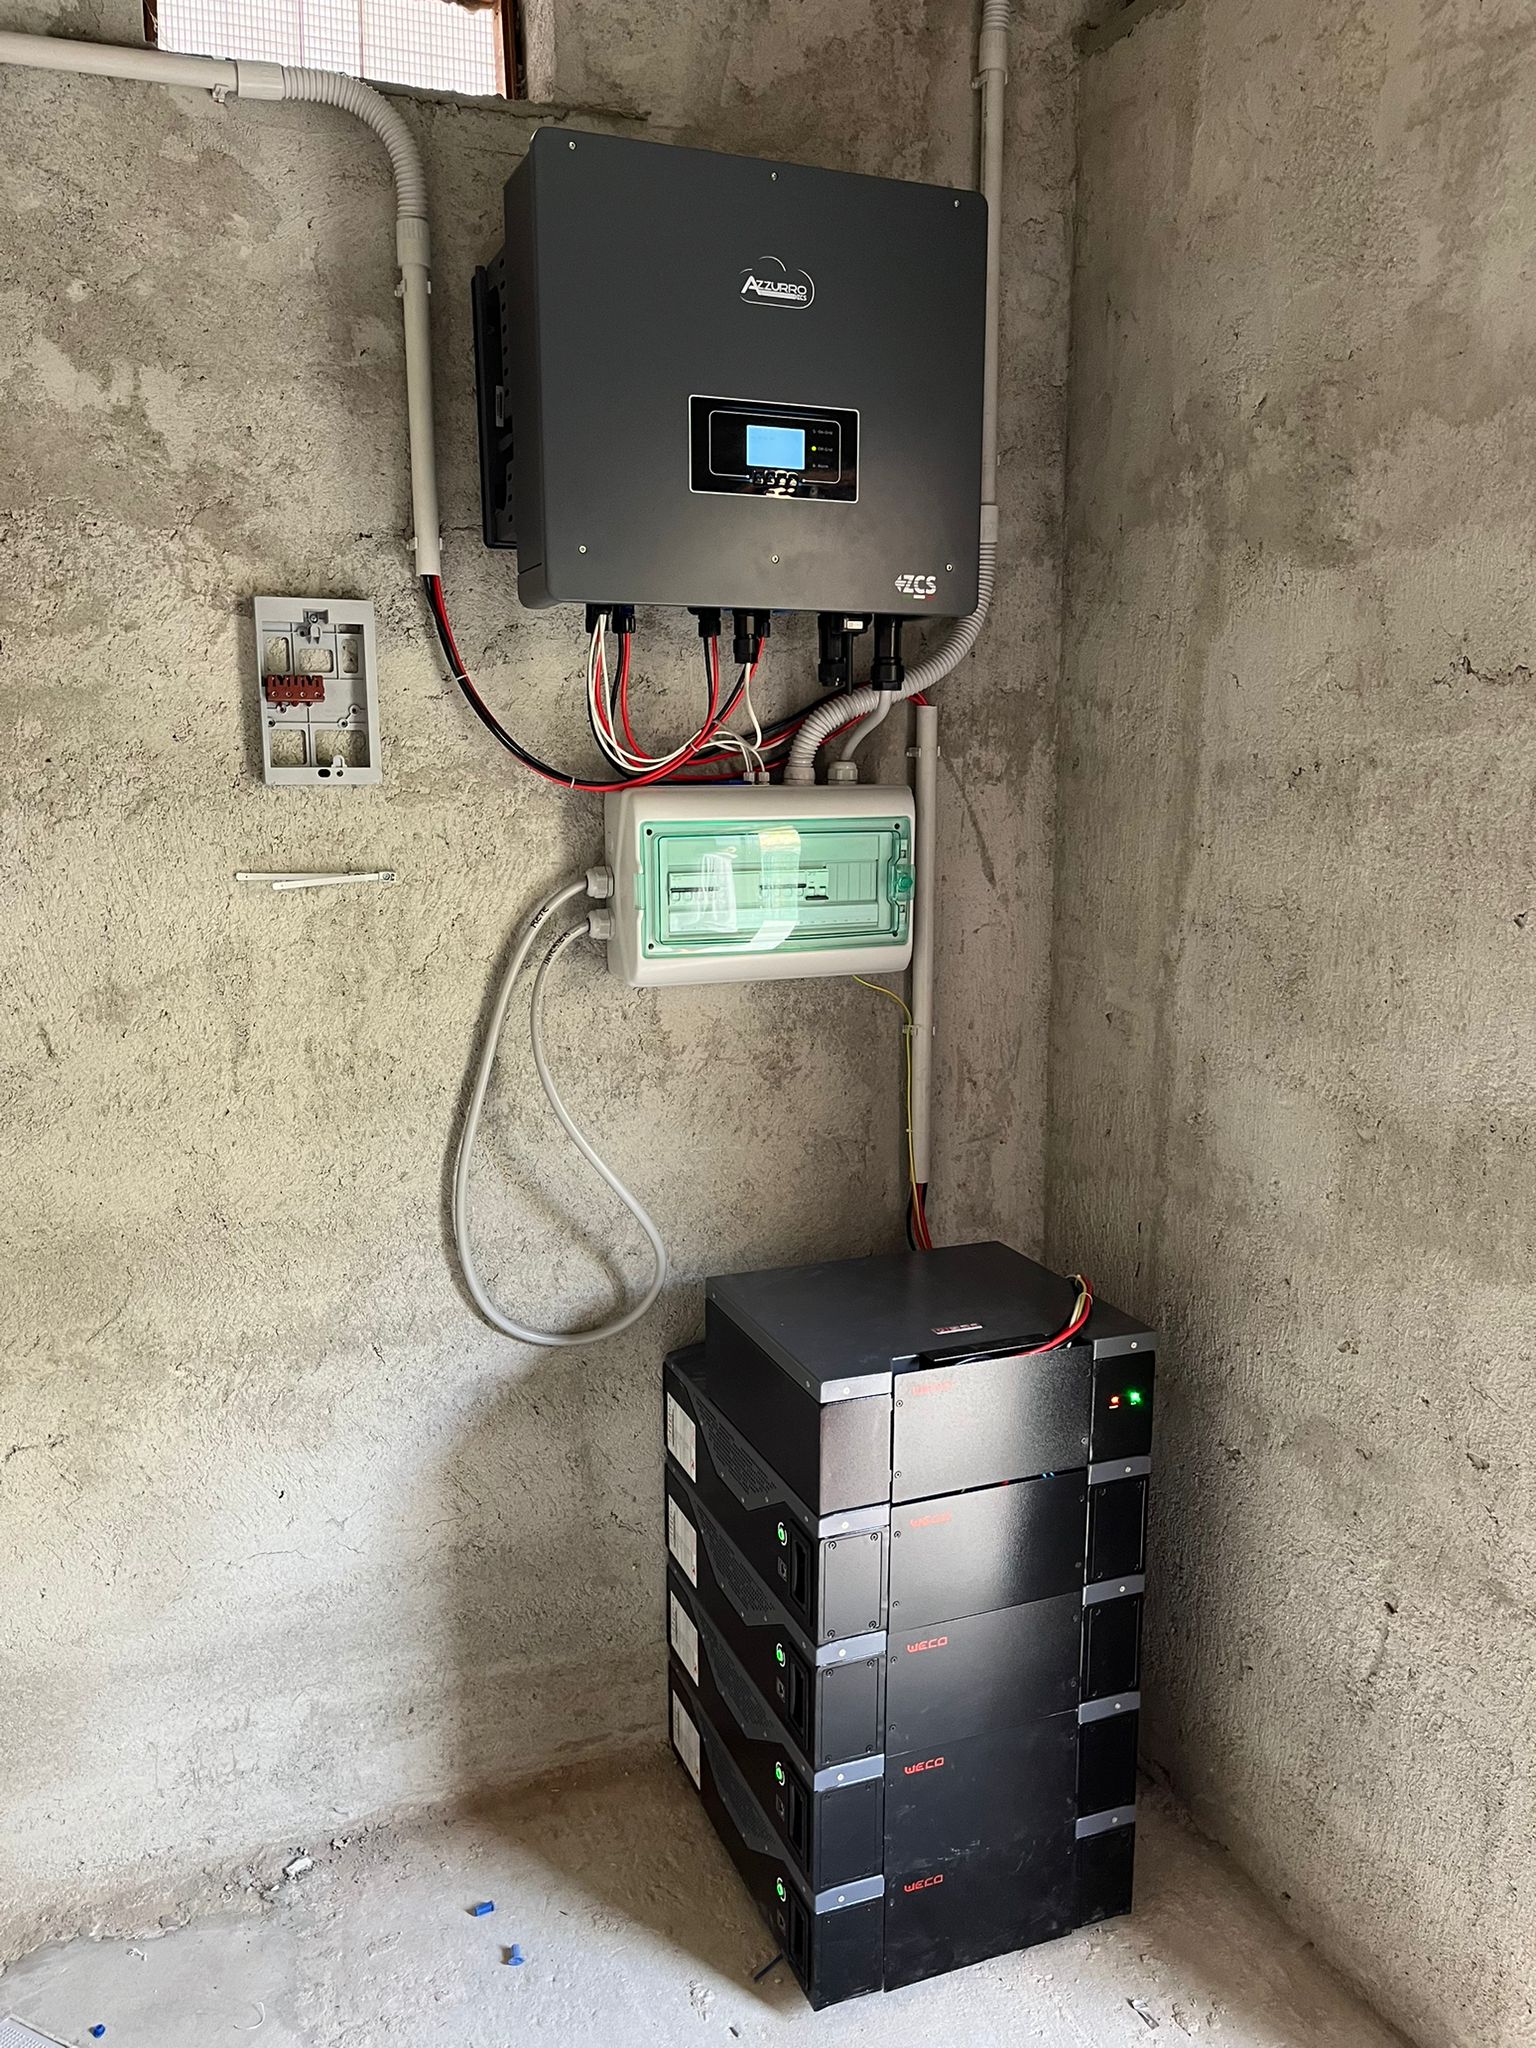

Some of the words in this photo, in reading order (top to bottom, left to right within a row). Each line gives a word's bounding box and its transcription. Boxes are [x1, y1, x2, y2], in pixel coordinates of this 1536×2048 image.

[741, 275, 807, 296] AZZURRO
[902, 575, 937, 594] ZCS
[907, 1636, 948, 1653] WECO
[904, 1757, 945, 1775] WECO
[904, 1874, 944, 1893] WECO
